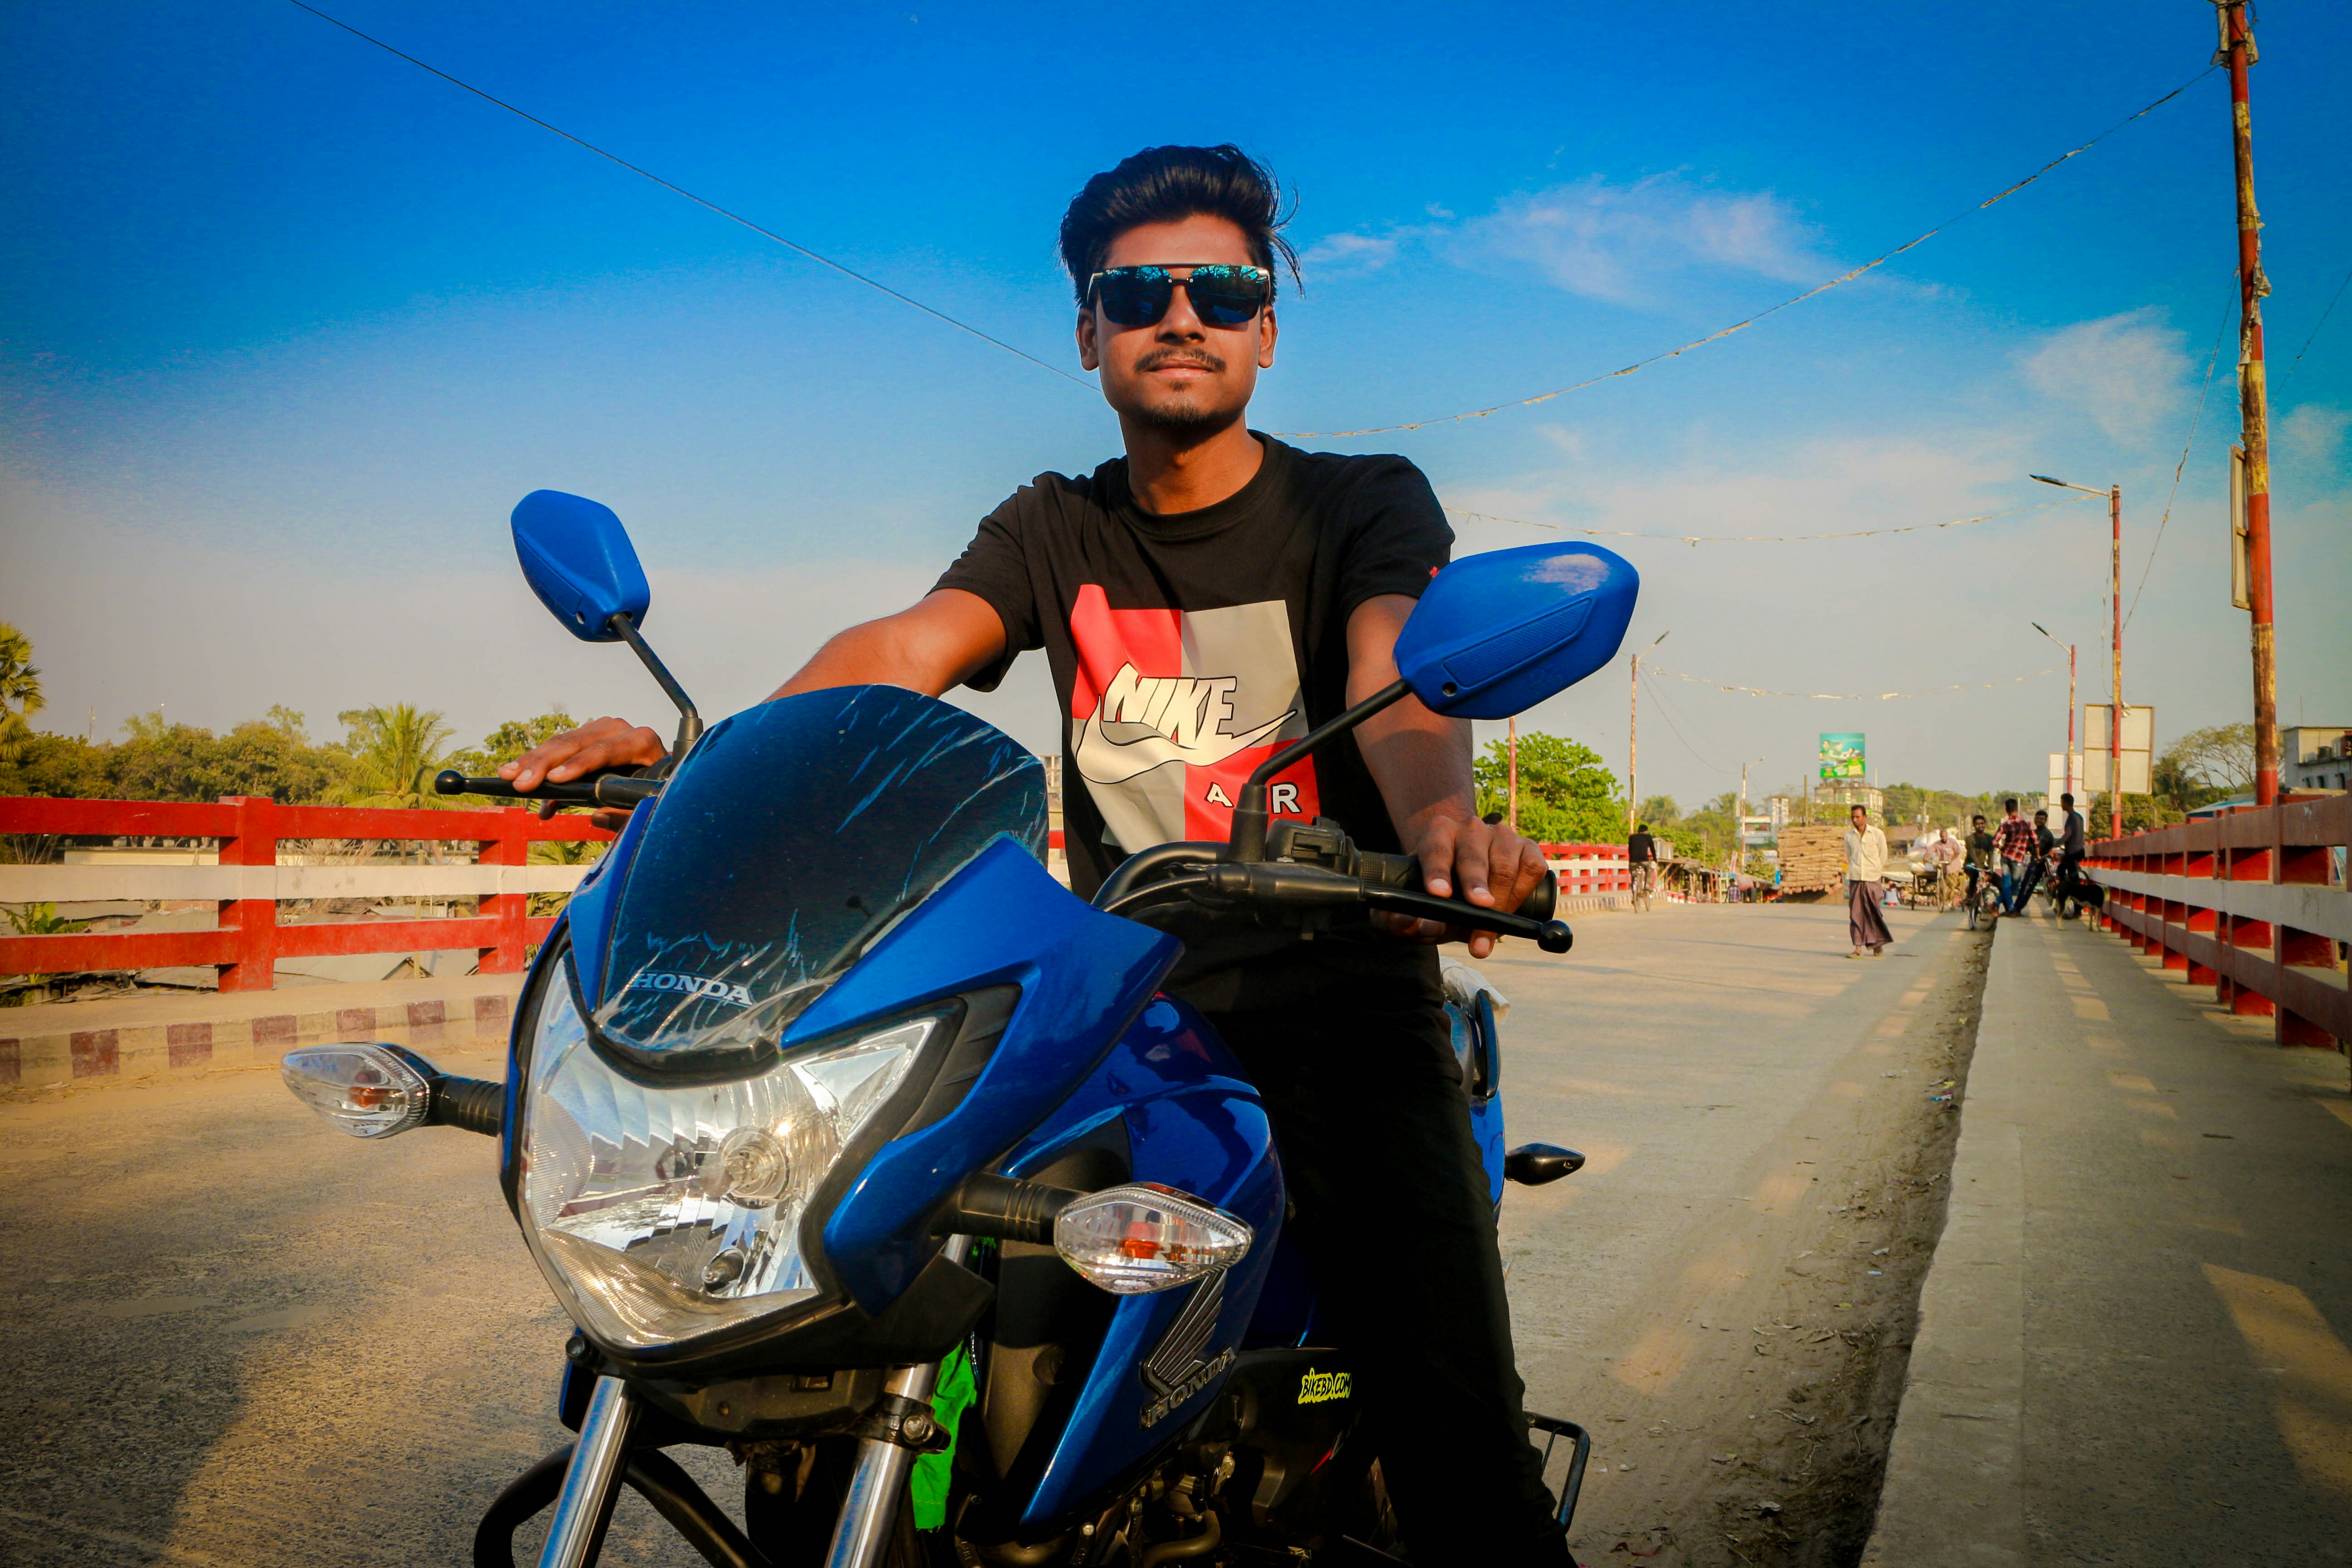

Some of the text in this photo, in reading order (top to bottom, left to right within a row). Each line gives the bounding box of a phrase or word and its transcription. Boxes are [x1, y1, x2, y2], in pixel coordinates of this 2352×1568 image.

[1103, 662, 1237, 750] NIKE
[1205, 782, 1302, 814] AR
[631, 973, 753, 1006] HONDA
[1147, 1347, 1237, 1428] HONDA
